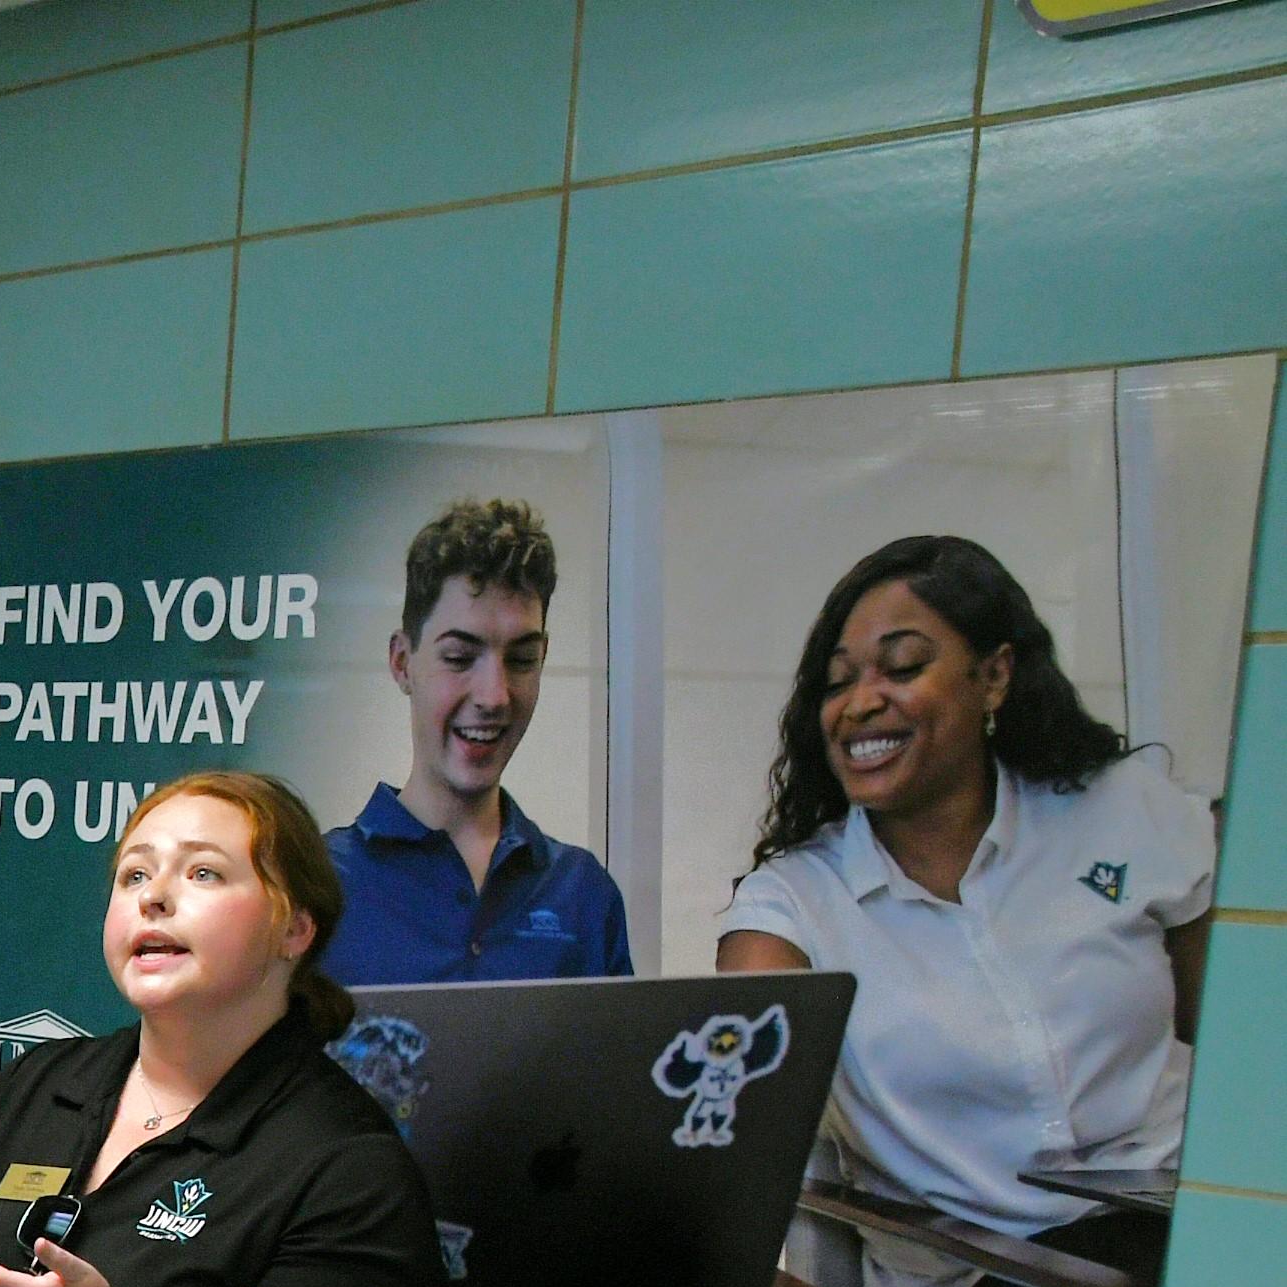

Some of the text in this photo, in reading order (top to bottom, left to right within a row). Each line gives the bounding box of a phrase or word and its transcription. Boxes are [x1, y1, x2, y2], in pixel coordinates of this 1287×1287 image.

[143, 574, 319, 642] YOUR
[74, 781, 156, 842] UN
[138, 1205, 206, 1238] UNCW
